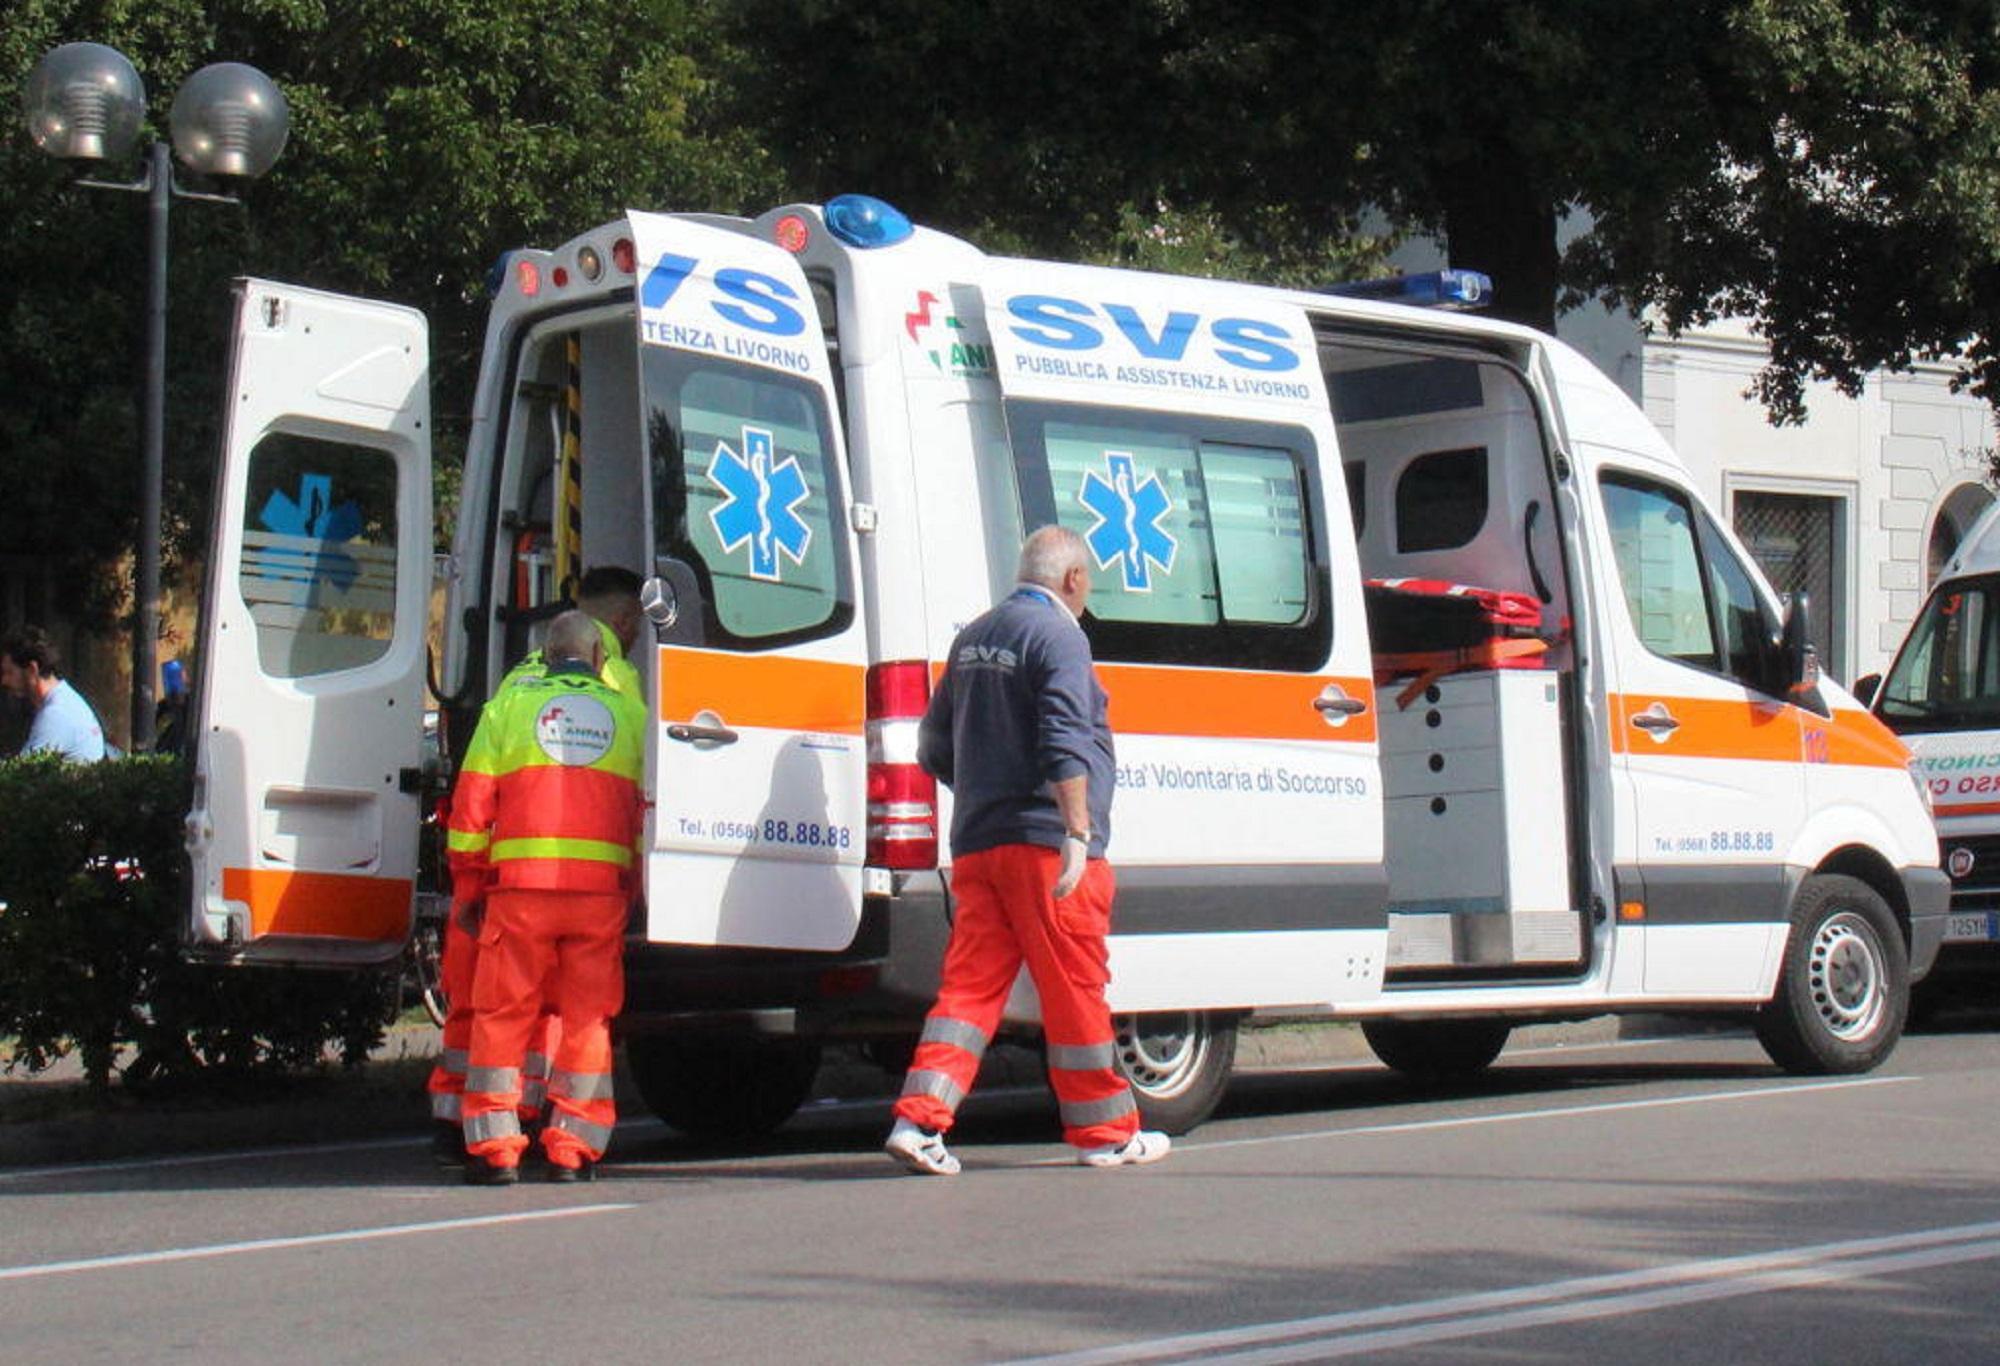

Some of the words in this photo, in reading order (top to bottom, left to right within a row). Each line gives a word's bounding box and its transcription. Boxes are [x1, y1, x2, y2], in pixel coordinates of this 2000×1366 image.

[1006, 294, 1300, 372] SVS
[724, 337, 810, 373] LIVORNO
[1014, 354, 1108, 380] PUBBLICA
[1116, 365, 1229, 391] ASSISTENZA
[1234, 378, 1310, 400] LIVORNO
[957, 644, 1019, 668] SVS
[1152, 764, 1253, 791] Volontaria
[1257, 770, 1275, 792] di
[1277, 768, 1367, 797] Soccorso
[678, 818, 707, 837] Tel.
[763, 818, 851, 850] 88.88.88
[1710, 830, 1775, 852] 88.88.88
